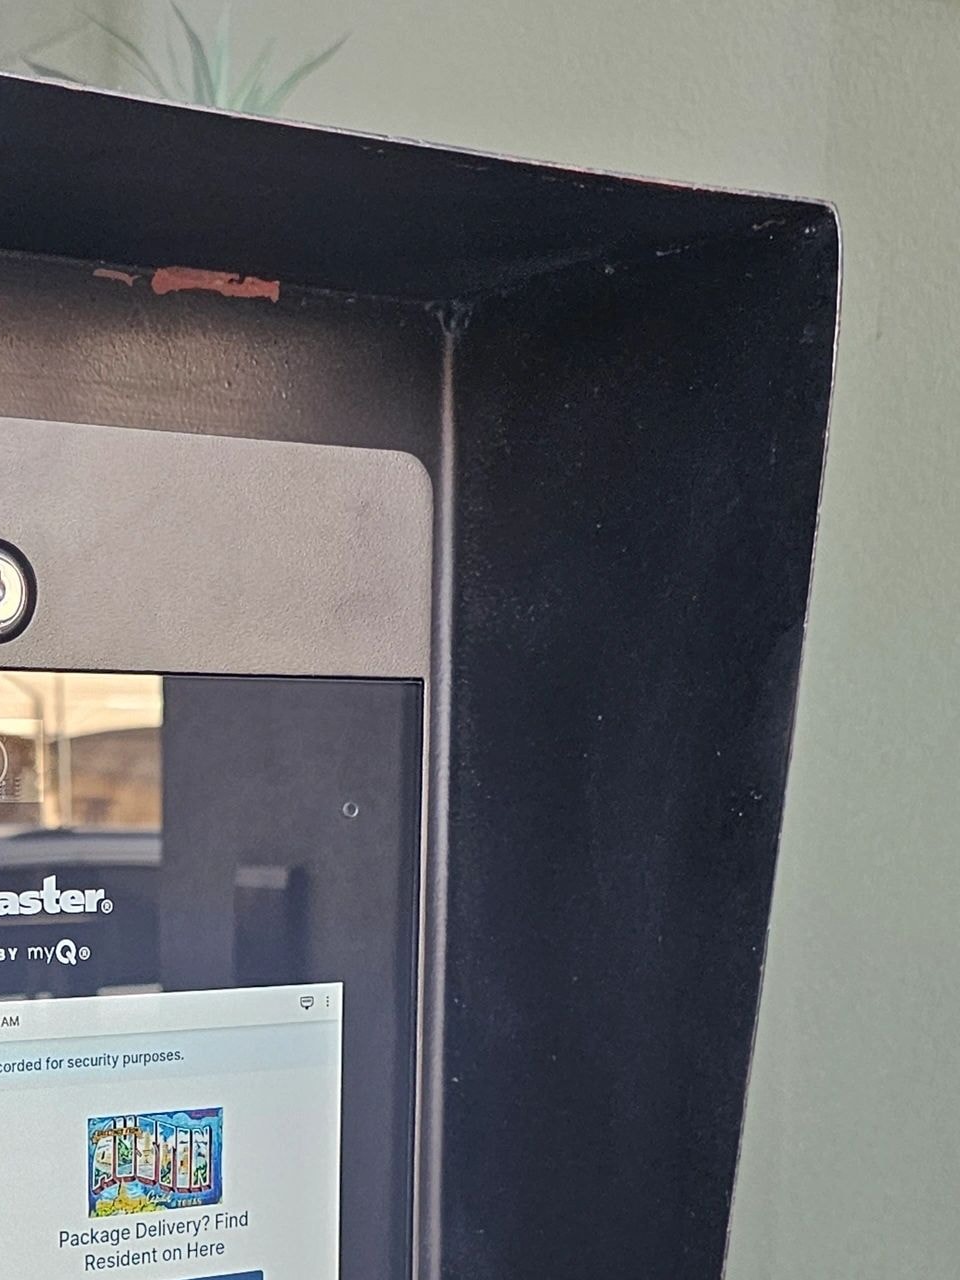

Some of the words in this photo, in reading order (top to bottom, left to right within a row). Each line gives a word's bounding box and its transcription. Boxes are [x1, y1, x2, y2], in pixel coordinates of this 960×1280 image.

[1, 1015, 20, 1027] AM
[45, 1056, 64, 1070] for
[67, 1052, 119, 1069] security
[122, 1048, 185, 1067] purposes.
[59, 1228, 131, 1248] Package
[136, 1215, 210, 1239] Delivery?
[215, 1211, 248, 1230] Find
[85, 1249, 158, 1271] Resident
[162, 1247, 182, 1261] on
[187, 1242, 225, 1259] Here
